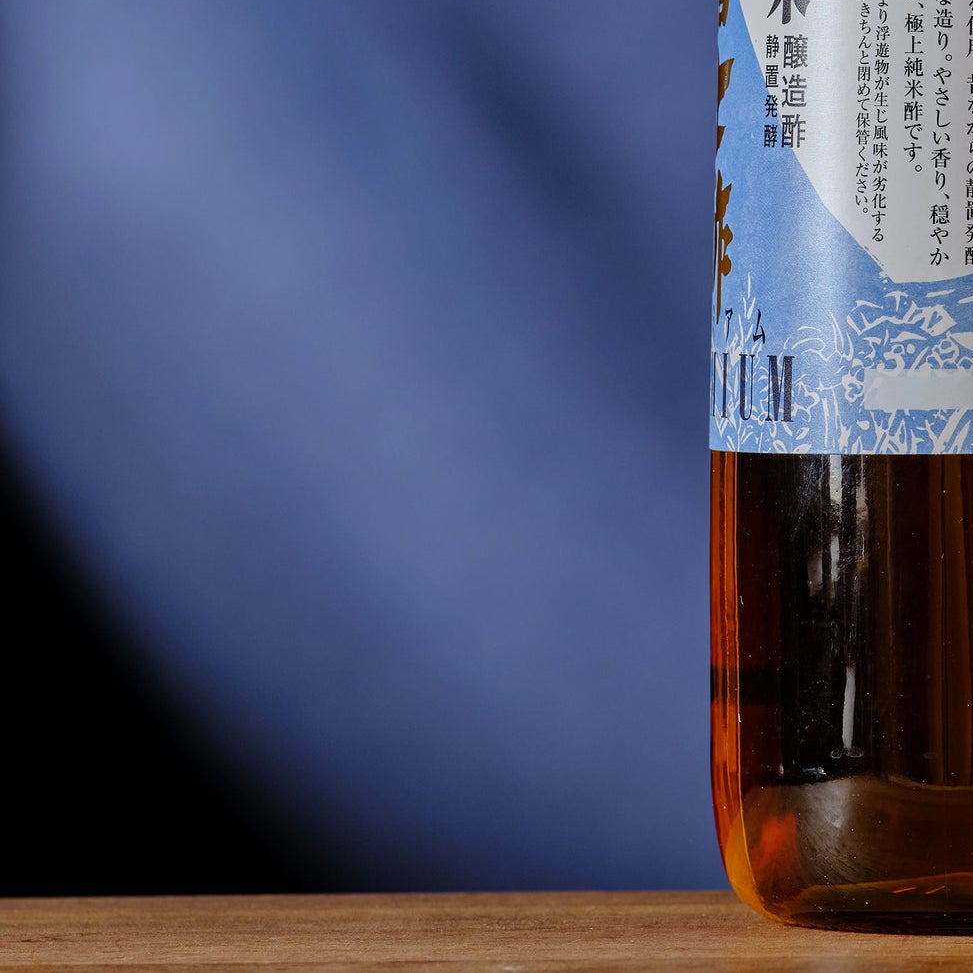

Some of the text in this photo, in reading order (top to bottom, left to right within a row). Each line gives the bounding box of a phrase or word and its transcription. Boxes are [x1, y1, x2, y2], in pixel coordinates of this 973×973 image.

[763, 34, 780, 148] 静置発酵
[781, 34, 808, 149] 醸造酢
